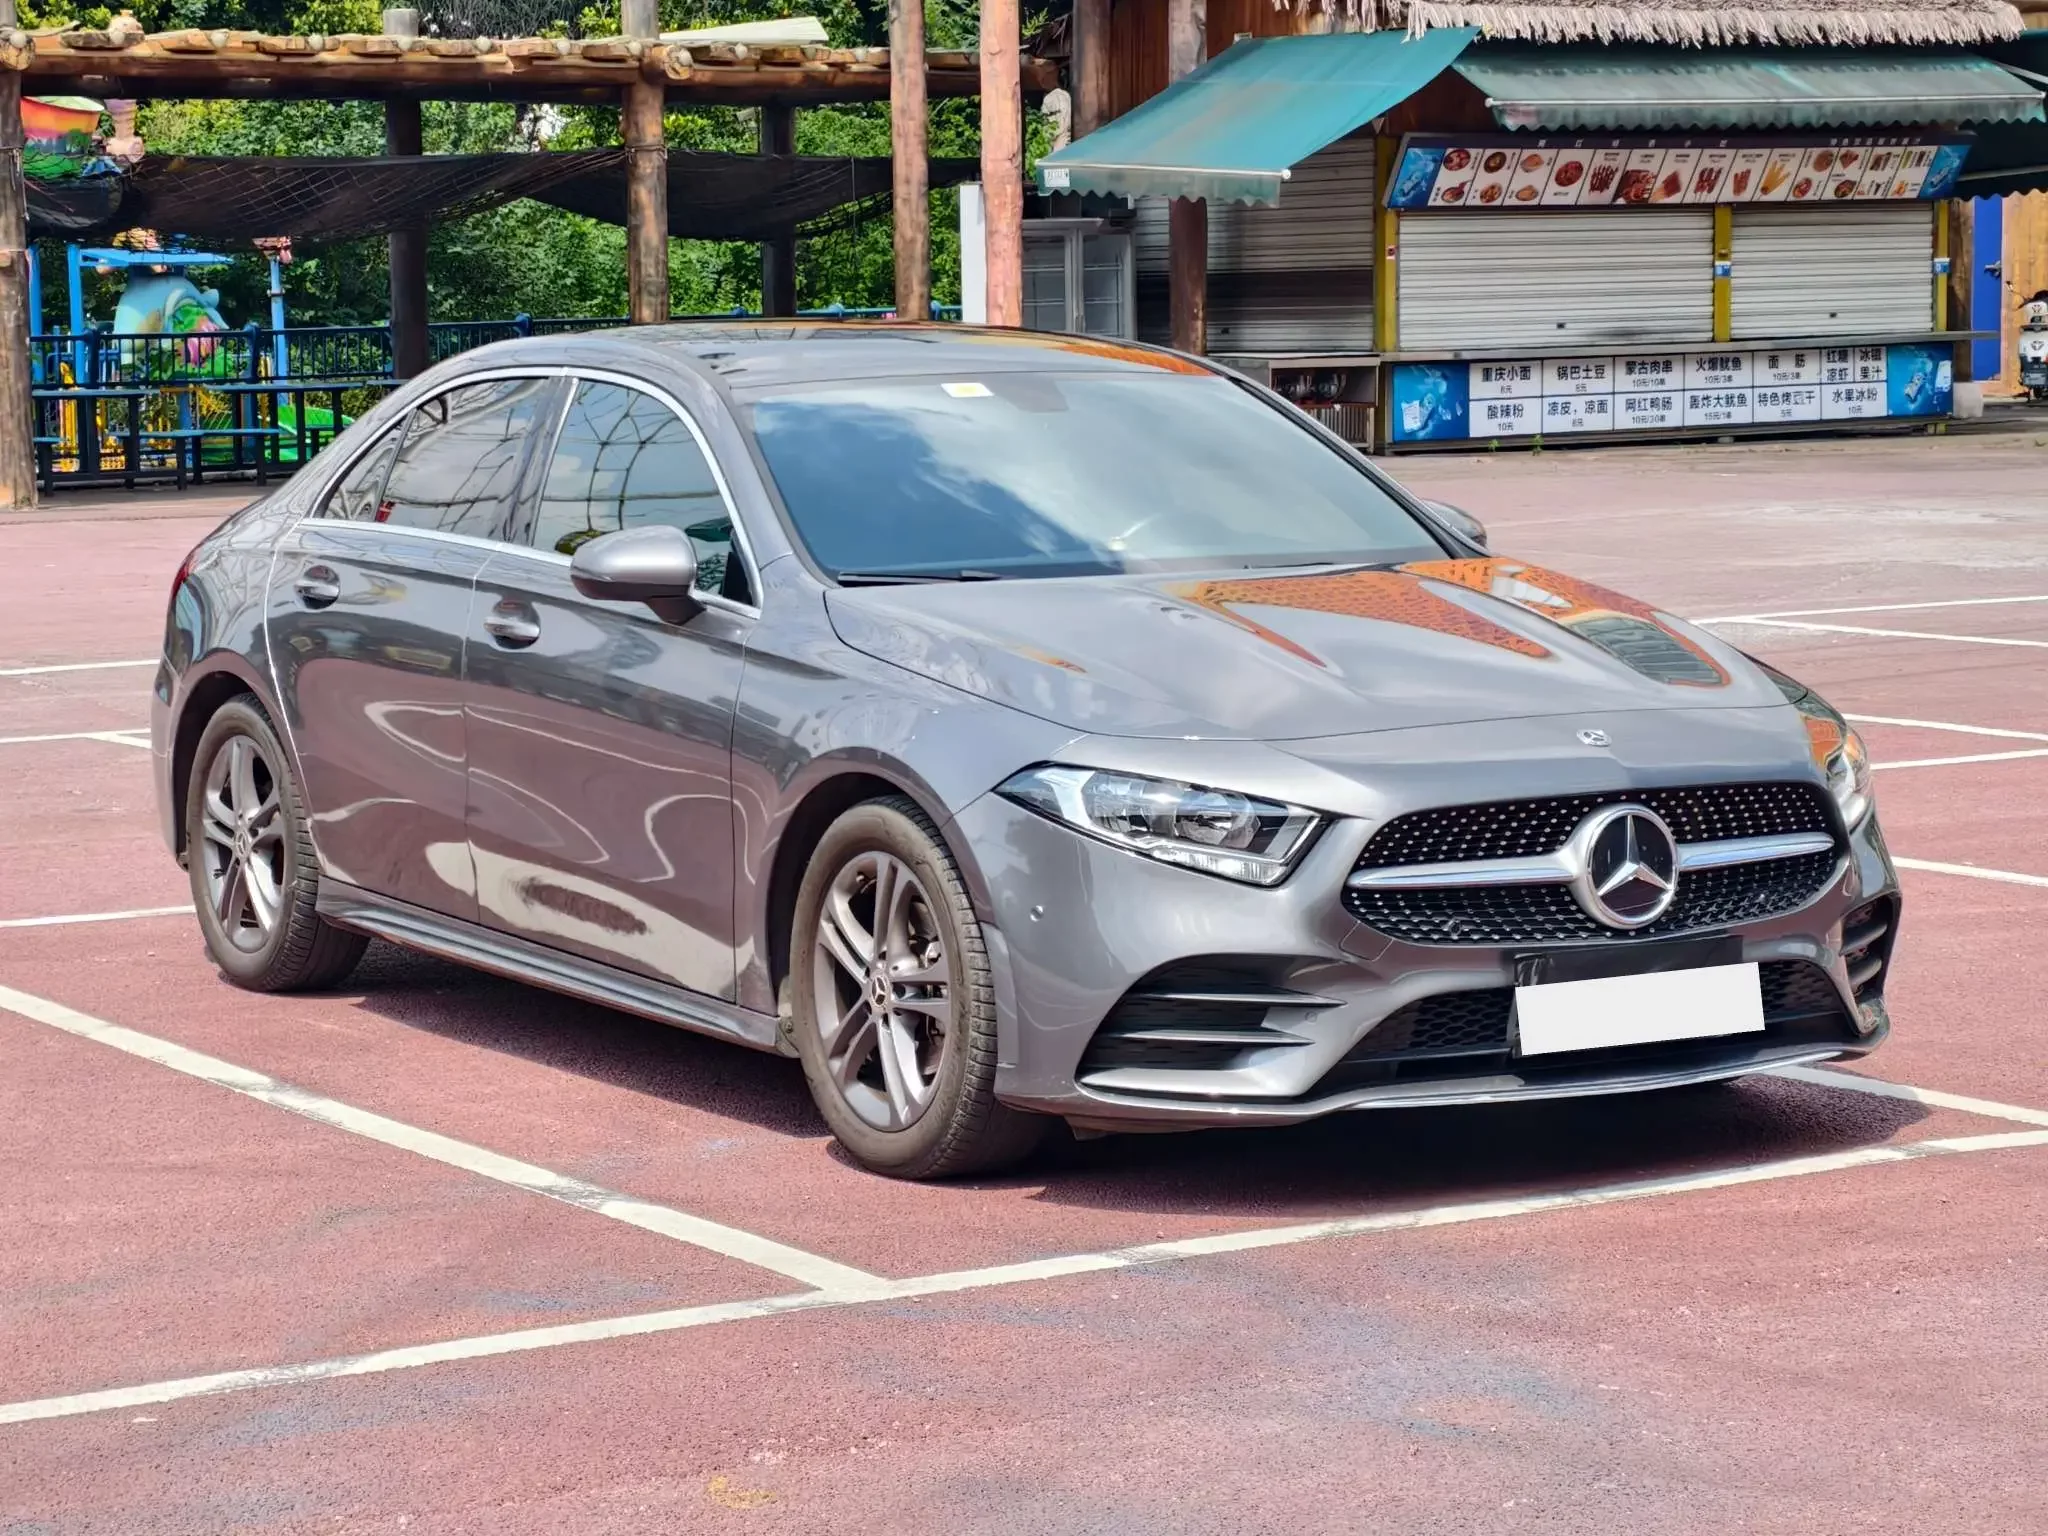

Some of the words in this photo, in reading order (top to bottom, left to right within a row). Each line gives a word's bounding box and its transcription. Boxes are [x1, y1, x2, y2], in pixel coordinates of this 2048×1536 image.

[1481, 365, 1532, 382] 重庆小面
[1557, 364, 1606, 381] 锅巴土豆
[1758, 390, 1816, 407] 特色烤豆干
[1487, 403, 1524, 420] 酸辣粉
